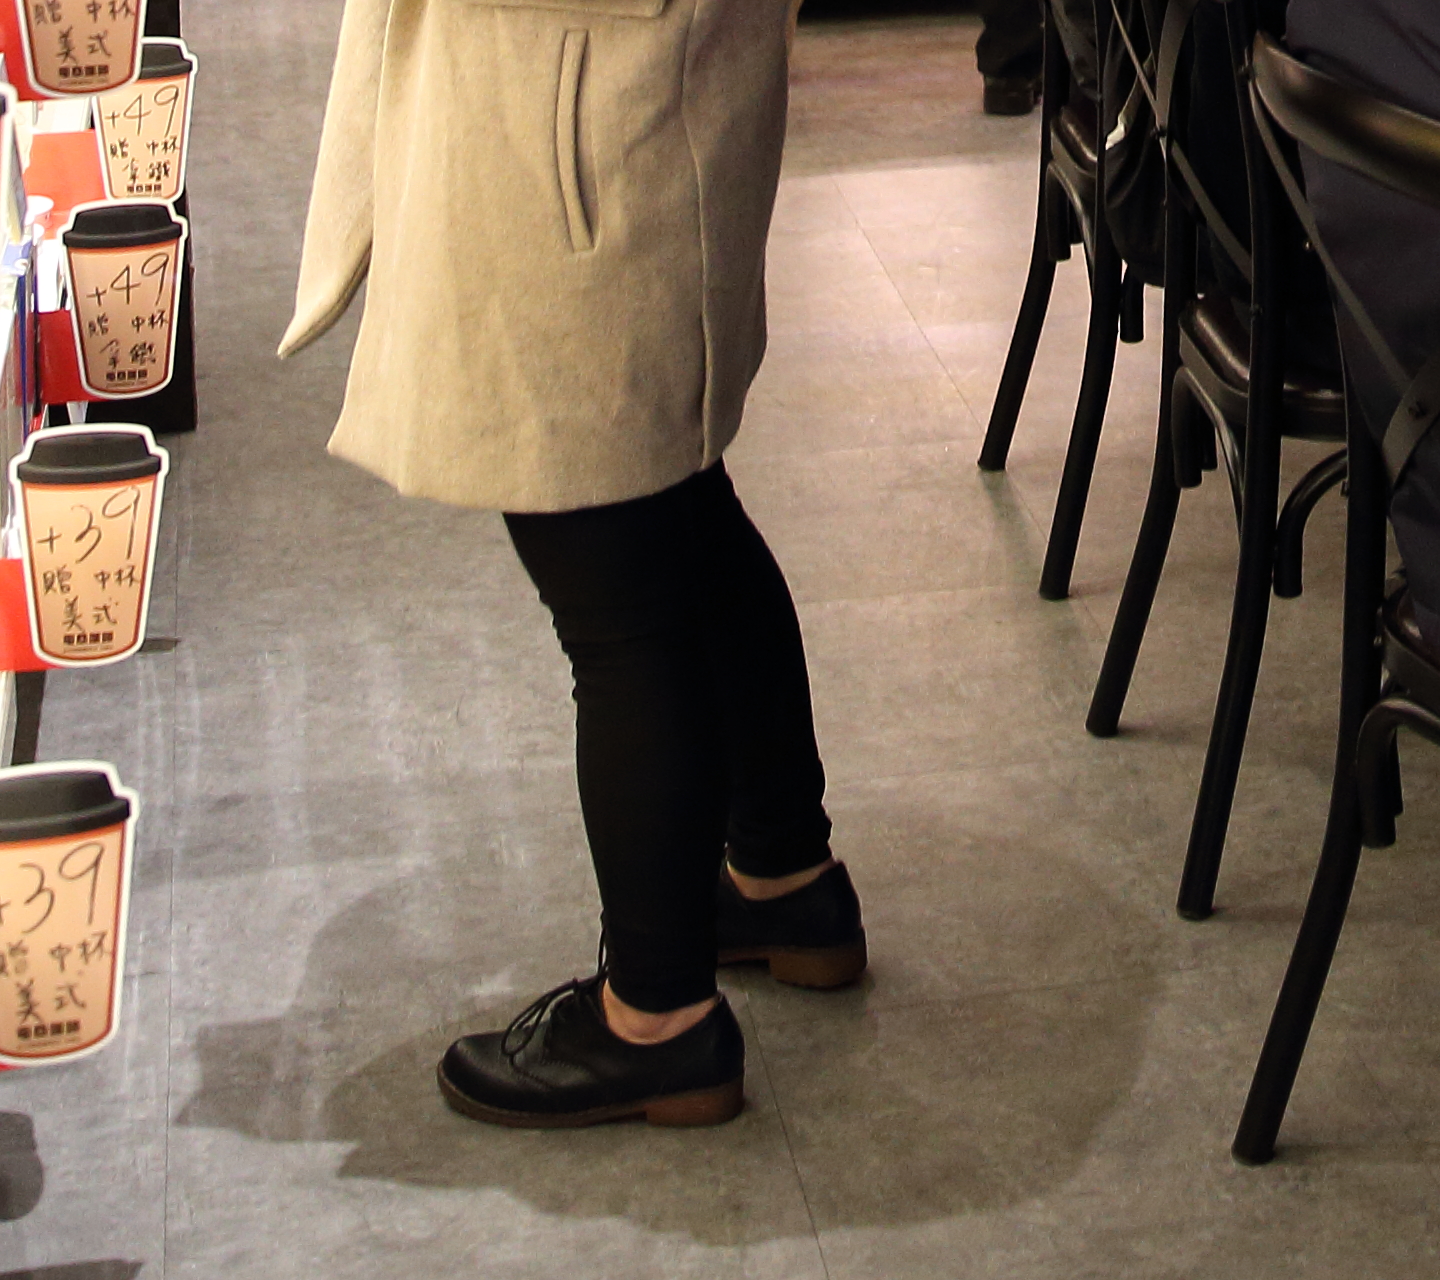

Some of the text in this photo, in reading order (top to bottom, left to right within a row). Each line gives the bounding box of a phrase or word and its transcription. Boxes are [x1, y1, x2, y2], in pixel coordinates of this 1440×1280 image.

[58, 24, 110, 62] 美式
[104, 84, 180, 138] +49
[146, 136, 180, 157] 中杯
[86, 252, 169, 306] +49
[131, 309, 168, 333] 中杯
[36, 484, 141, 564] +39
[93, 564, 140, 588] 中杯
[62, 595, 118, 632] 美式
